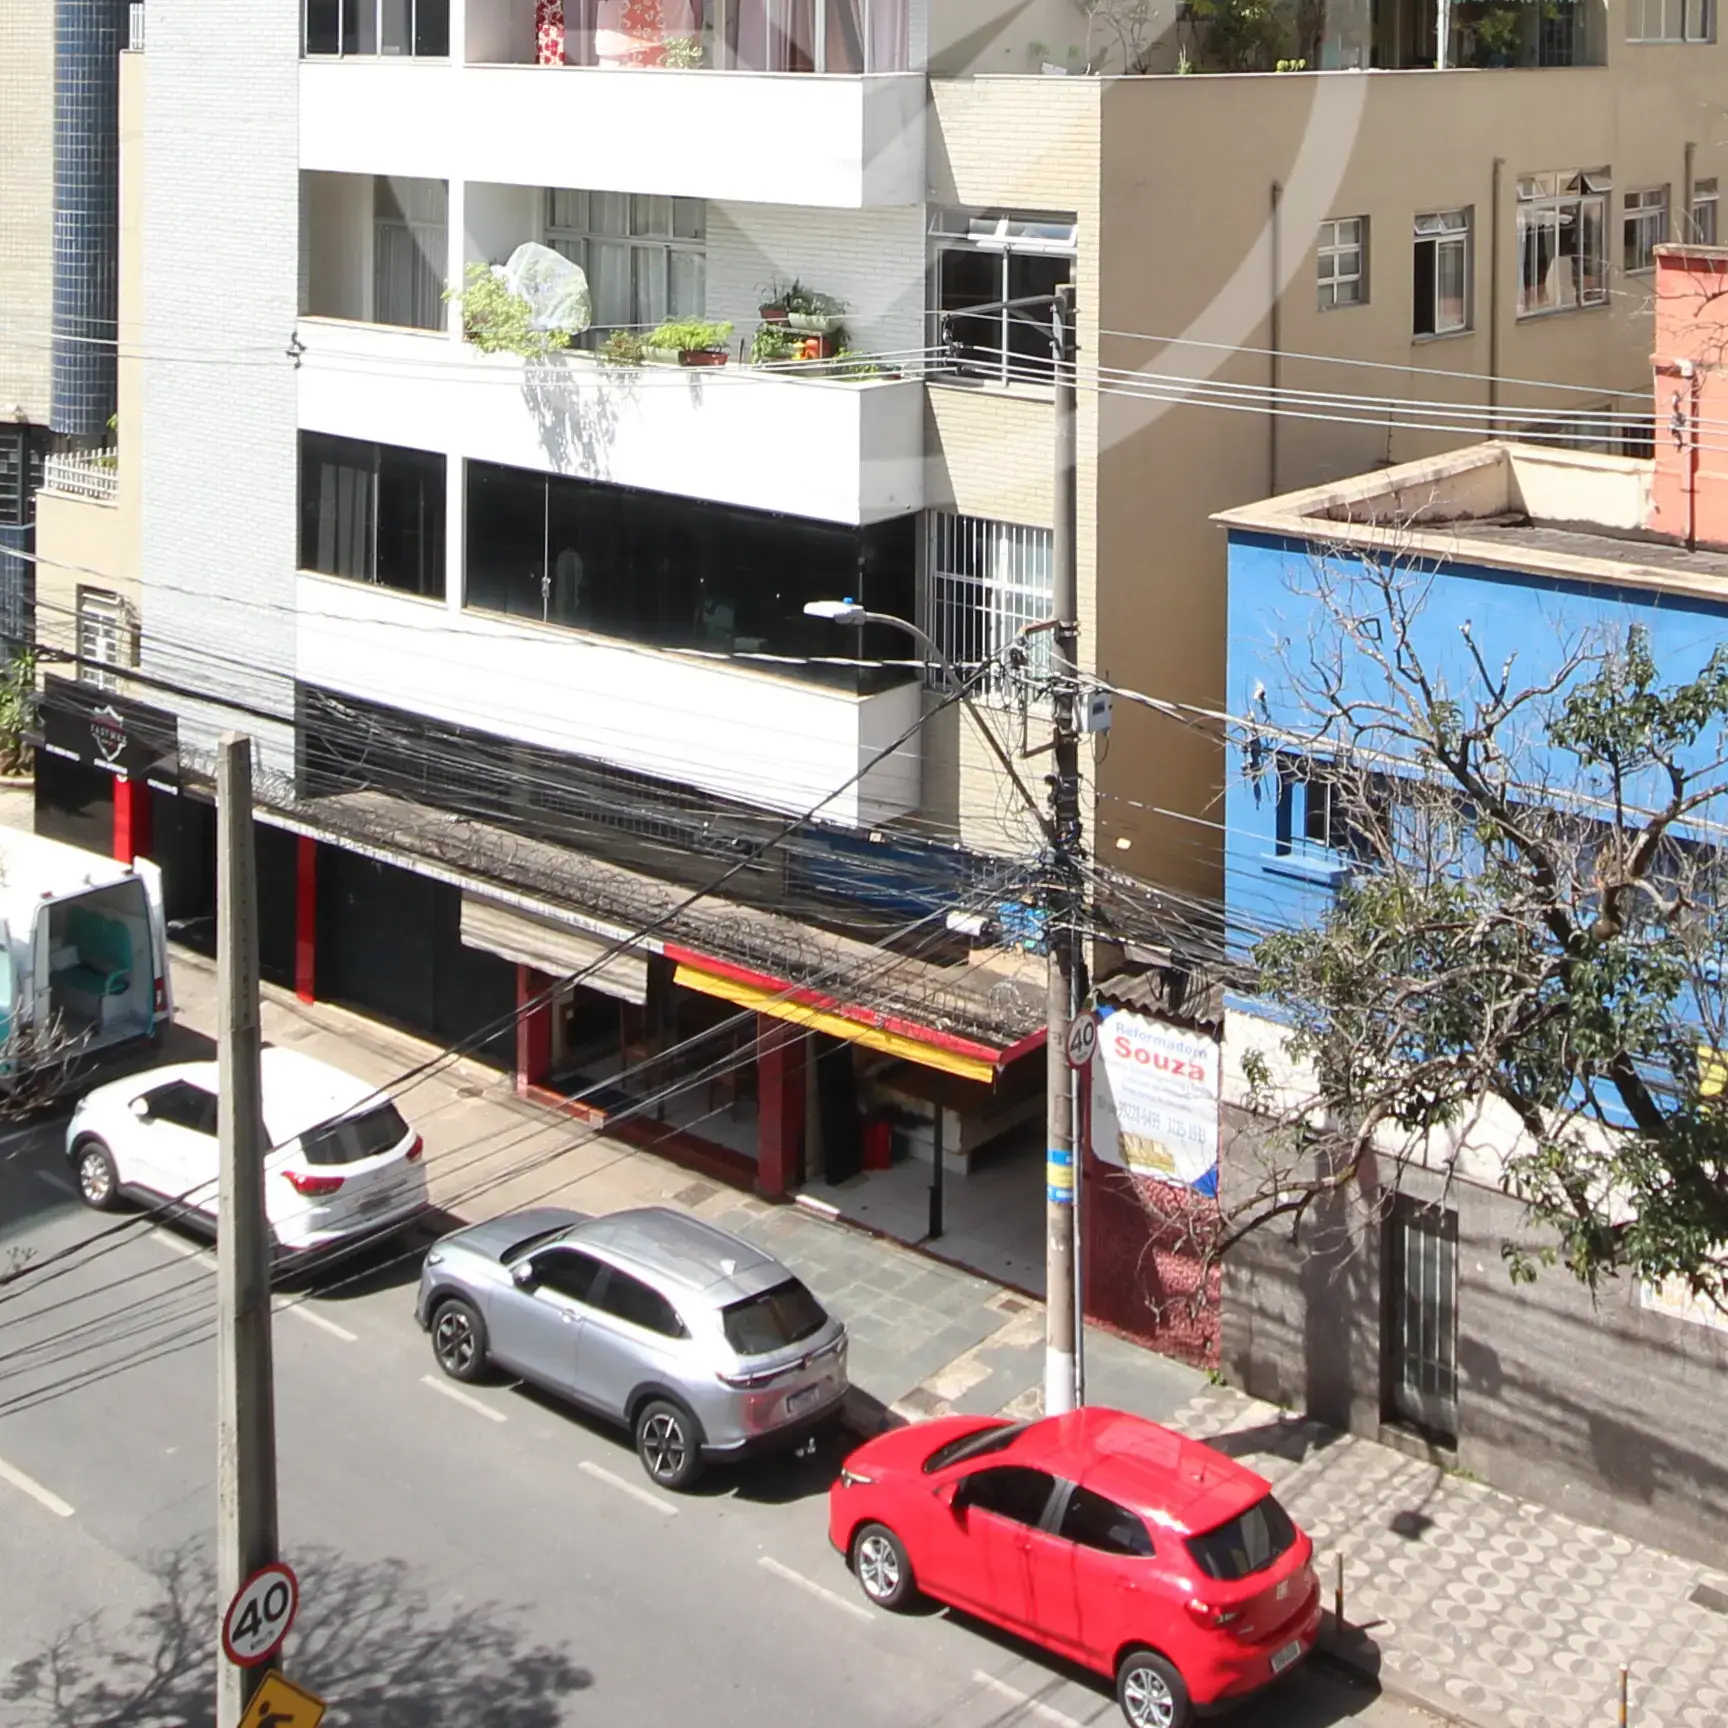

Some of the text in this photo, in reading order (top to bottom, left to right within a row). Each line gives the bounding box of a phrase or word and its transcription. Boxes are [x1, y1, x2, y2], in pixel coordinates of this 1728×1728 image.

[1069, 1021, 1094, 1053] 40
[1113, 1035, 1206, 1083] Souza
[231, 1580, 289, 1643] 40
